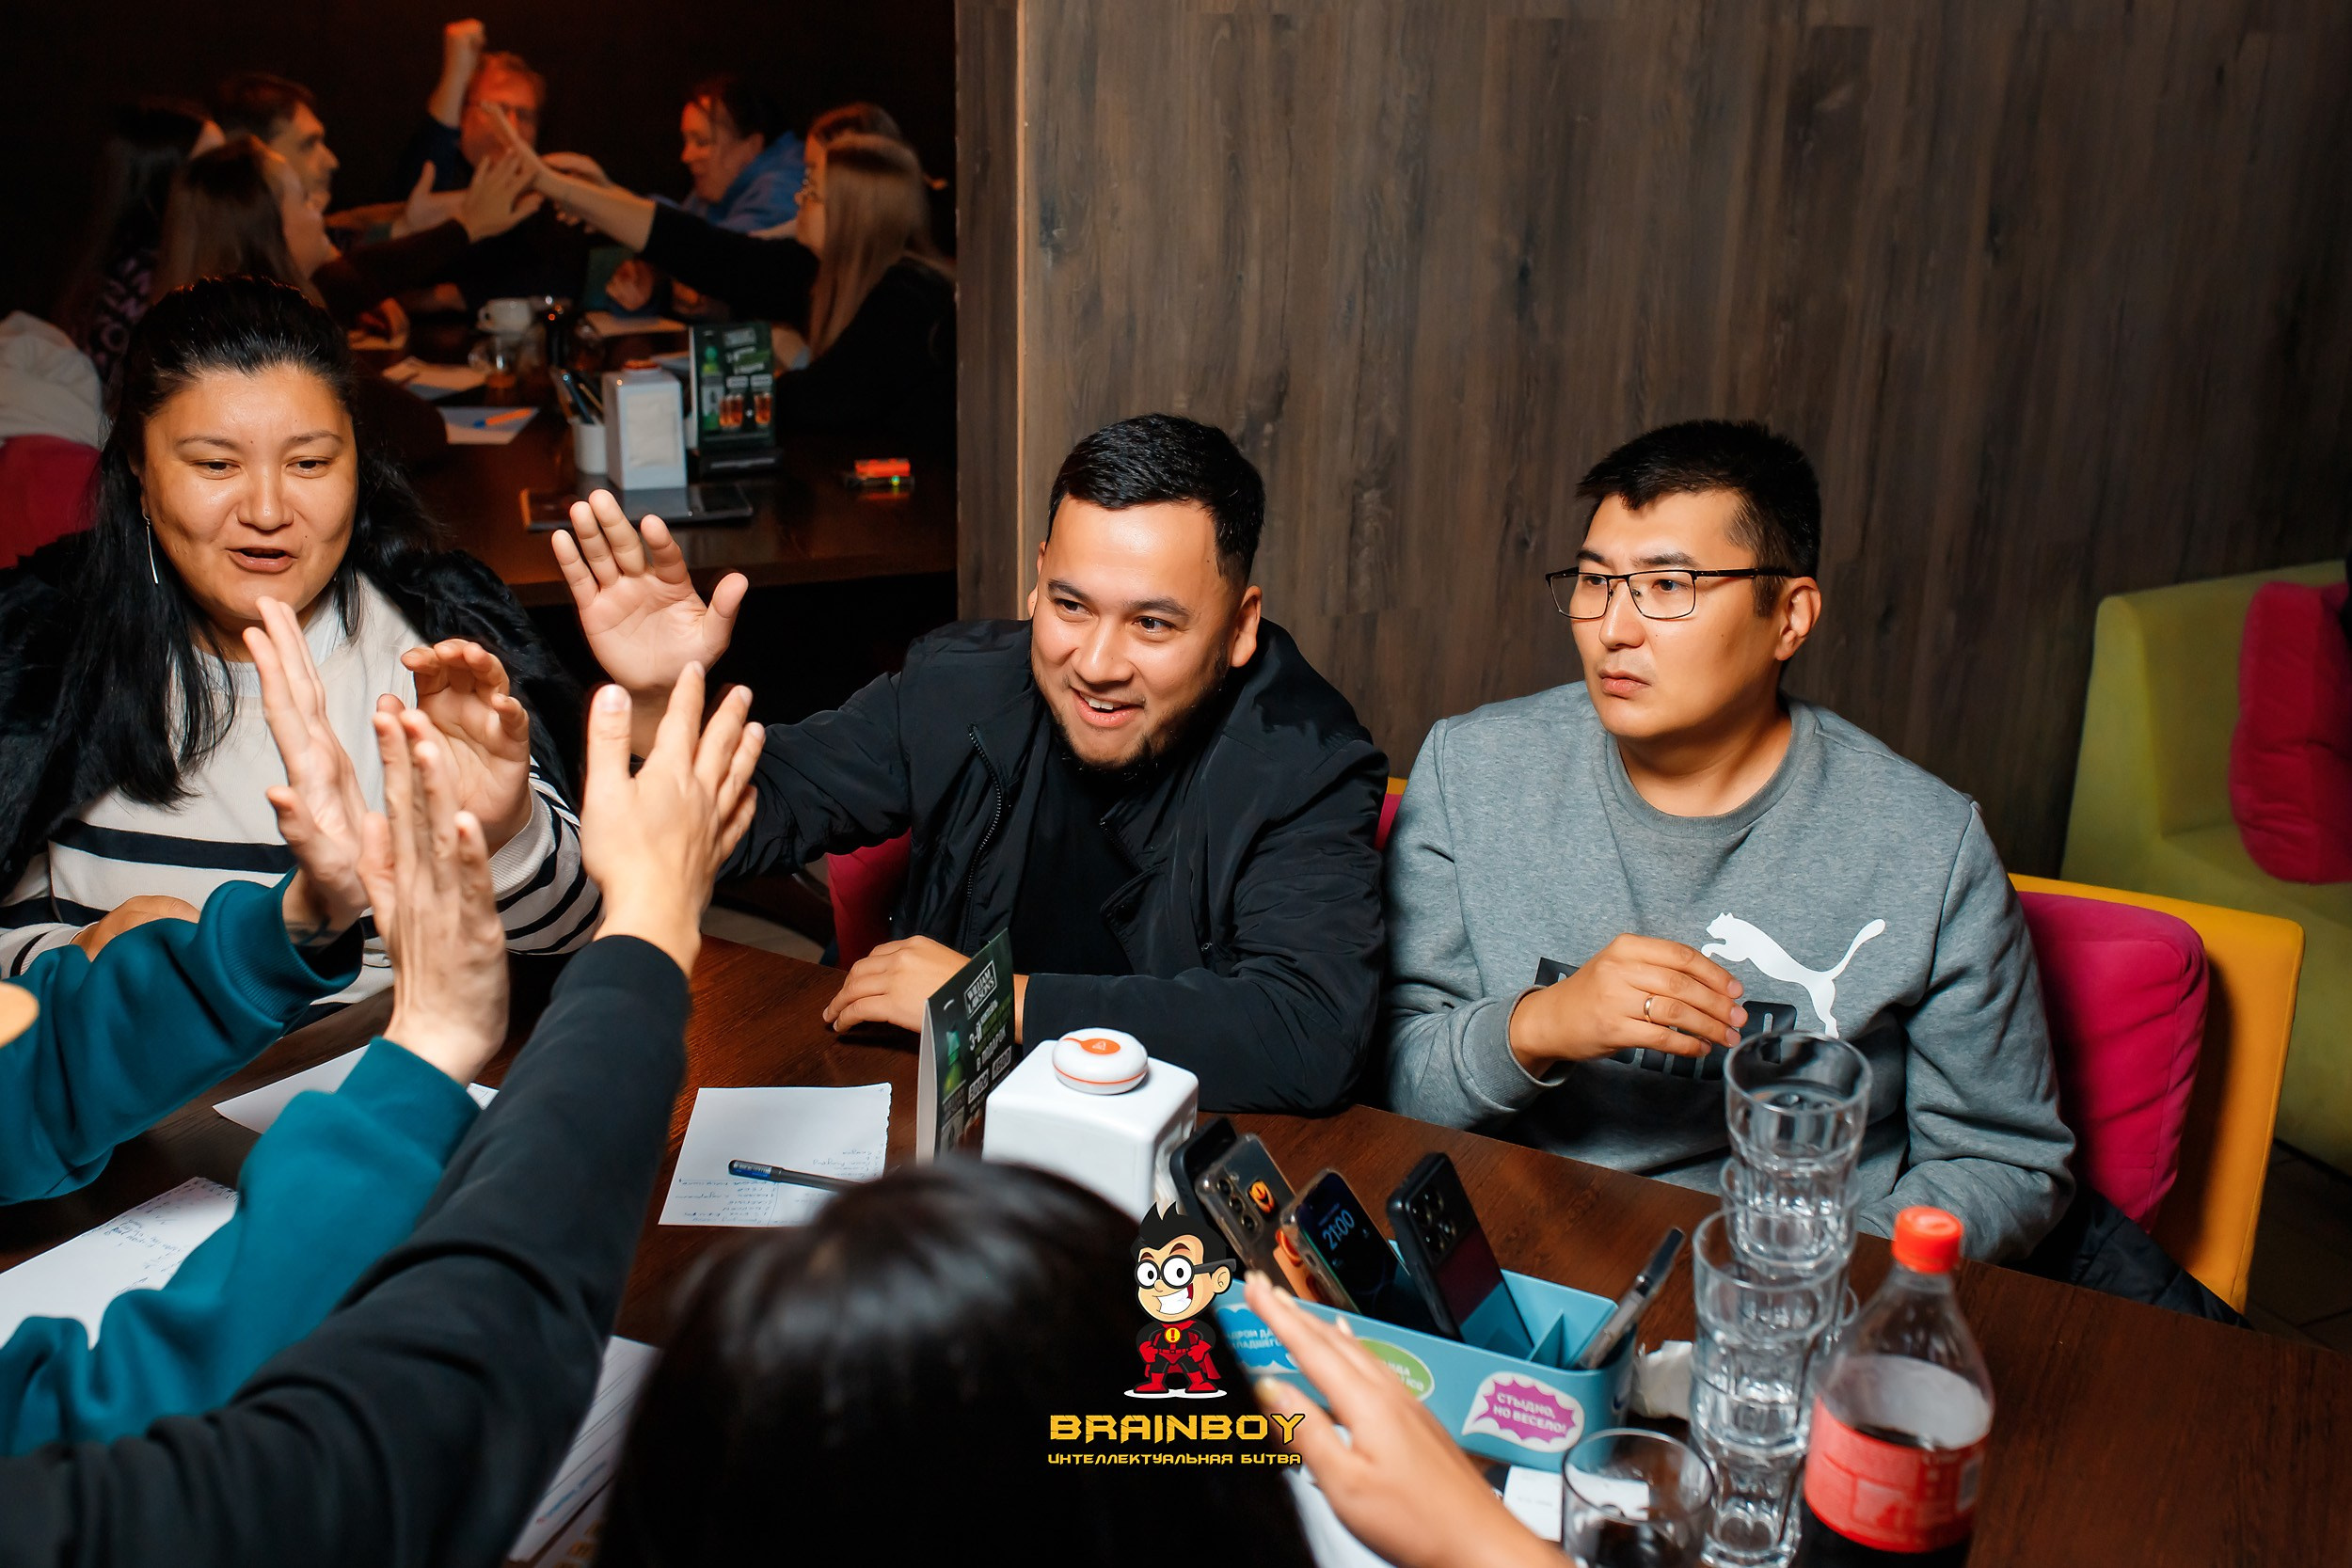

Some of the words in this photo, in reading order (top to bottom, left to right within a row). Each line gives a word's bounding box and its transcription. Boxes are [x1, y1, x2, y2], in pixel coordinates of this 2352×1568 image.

[1492, 1404, 1511, 1418] НО
[1513, 1410, 1567, 1433] ВЕСЕЛО!
[1497, 1392, 1555, 1419] СТЫДНО,
